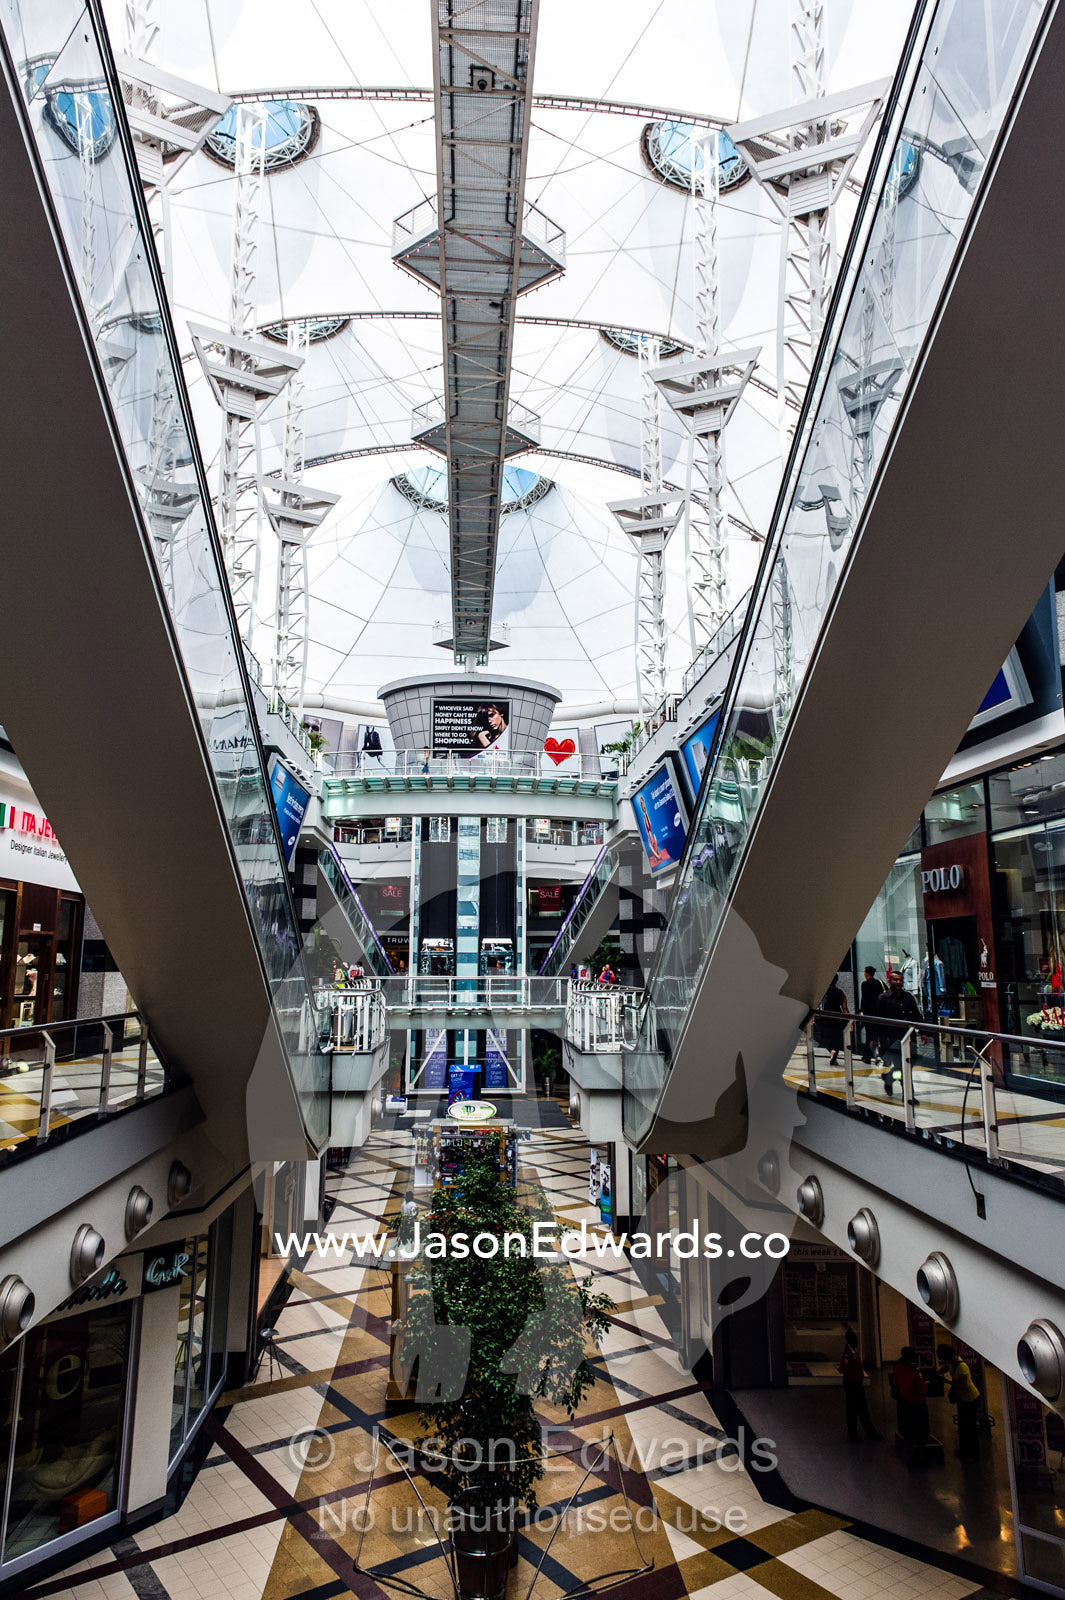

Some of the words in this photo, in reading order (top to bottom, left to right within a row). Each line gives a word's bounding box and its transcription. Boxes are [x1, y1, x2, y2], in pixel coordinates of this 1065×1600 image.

[22, 811, 36, 834] ITA
[10, 839, 33, 855] Designer
[920, 864, 962, 894] POLO
[382, 889, 403, 898] SALE
[539, 889, 560, 899] SALE
[978, 971, 994, 981] POLO
[793, 1247, 808, 1256] this
[810, 1247, 837, 1256] week's
